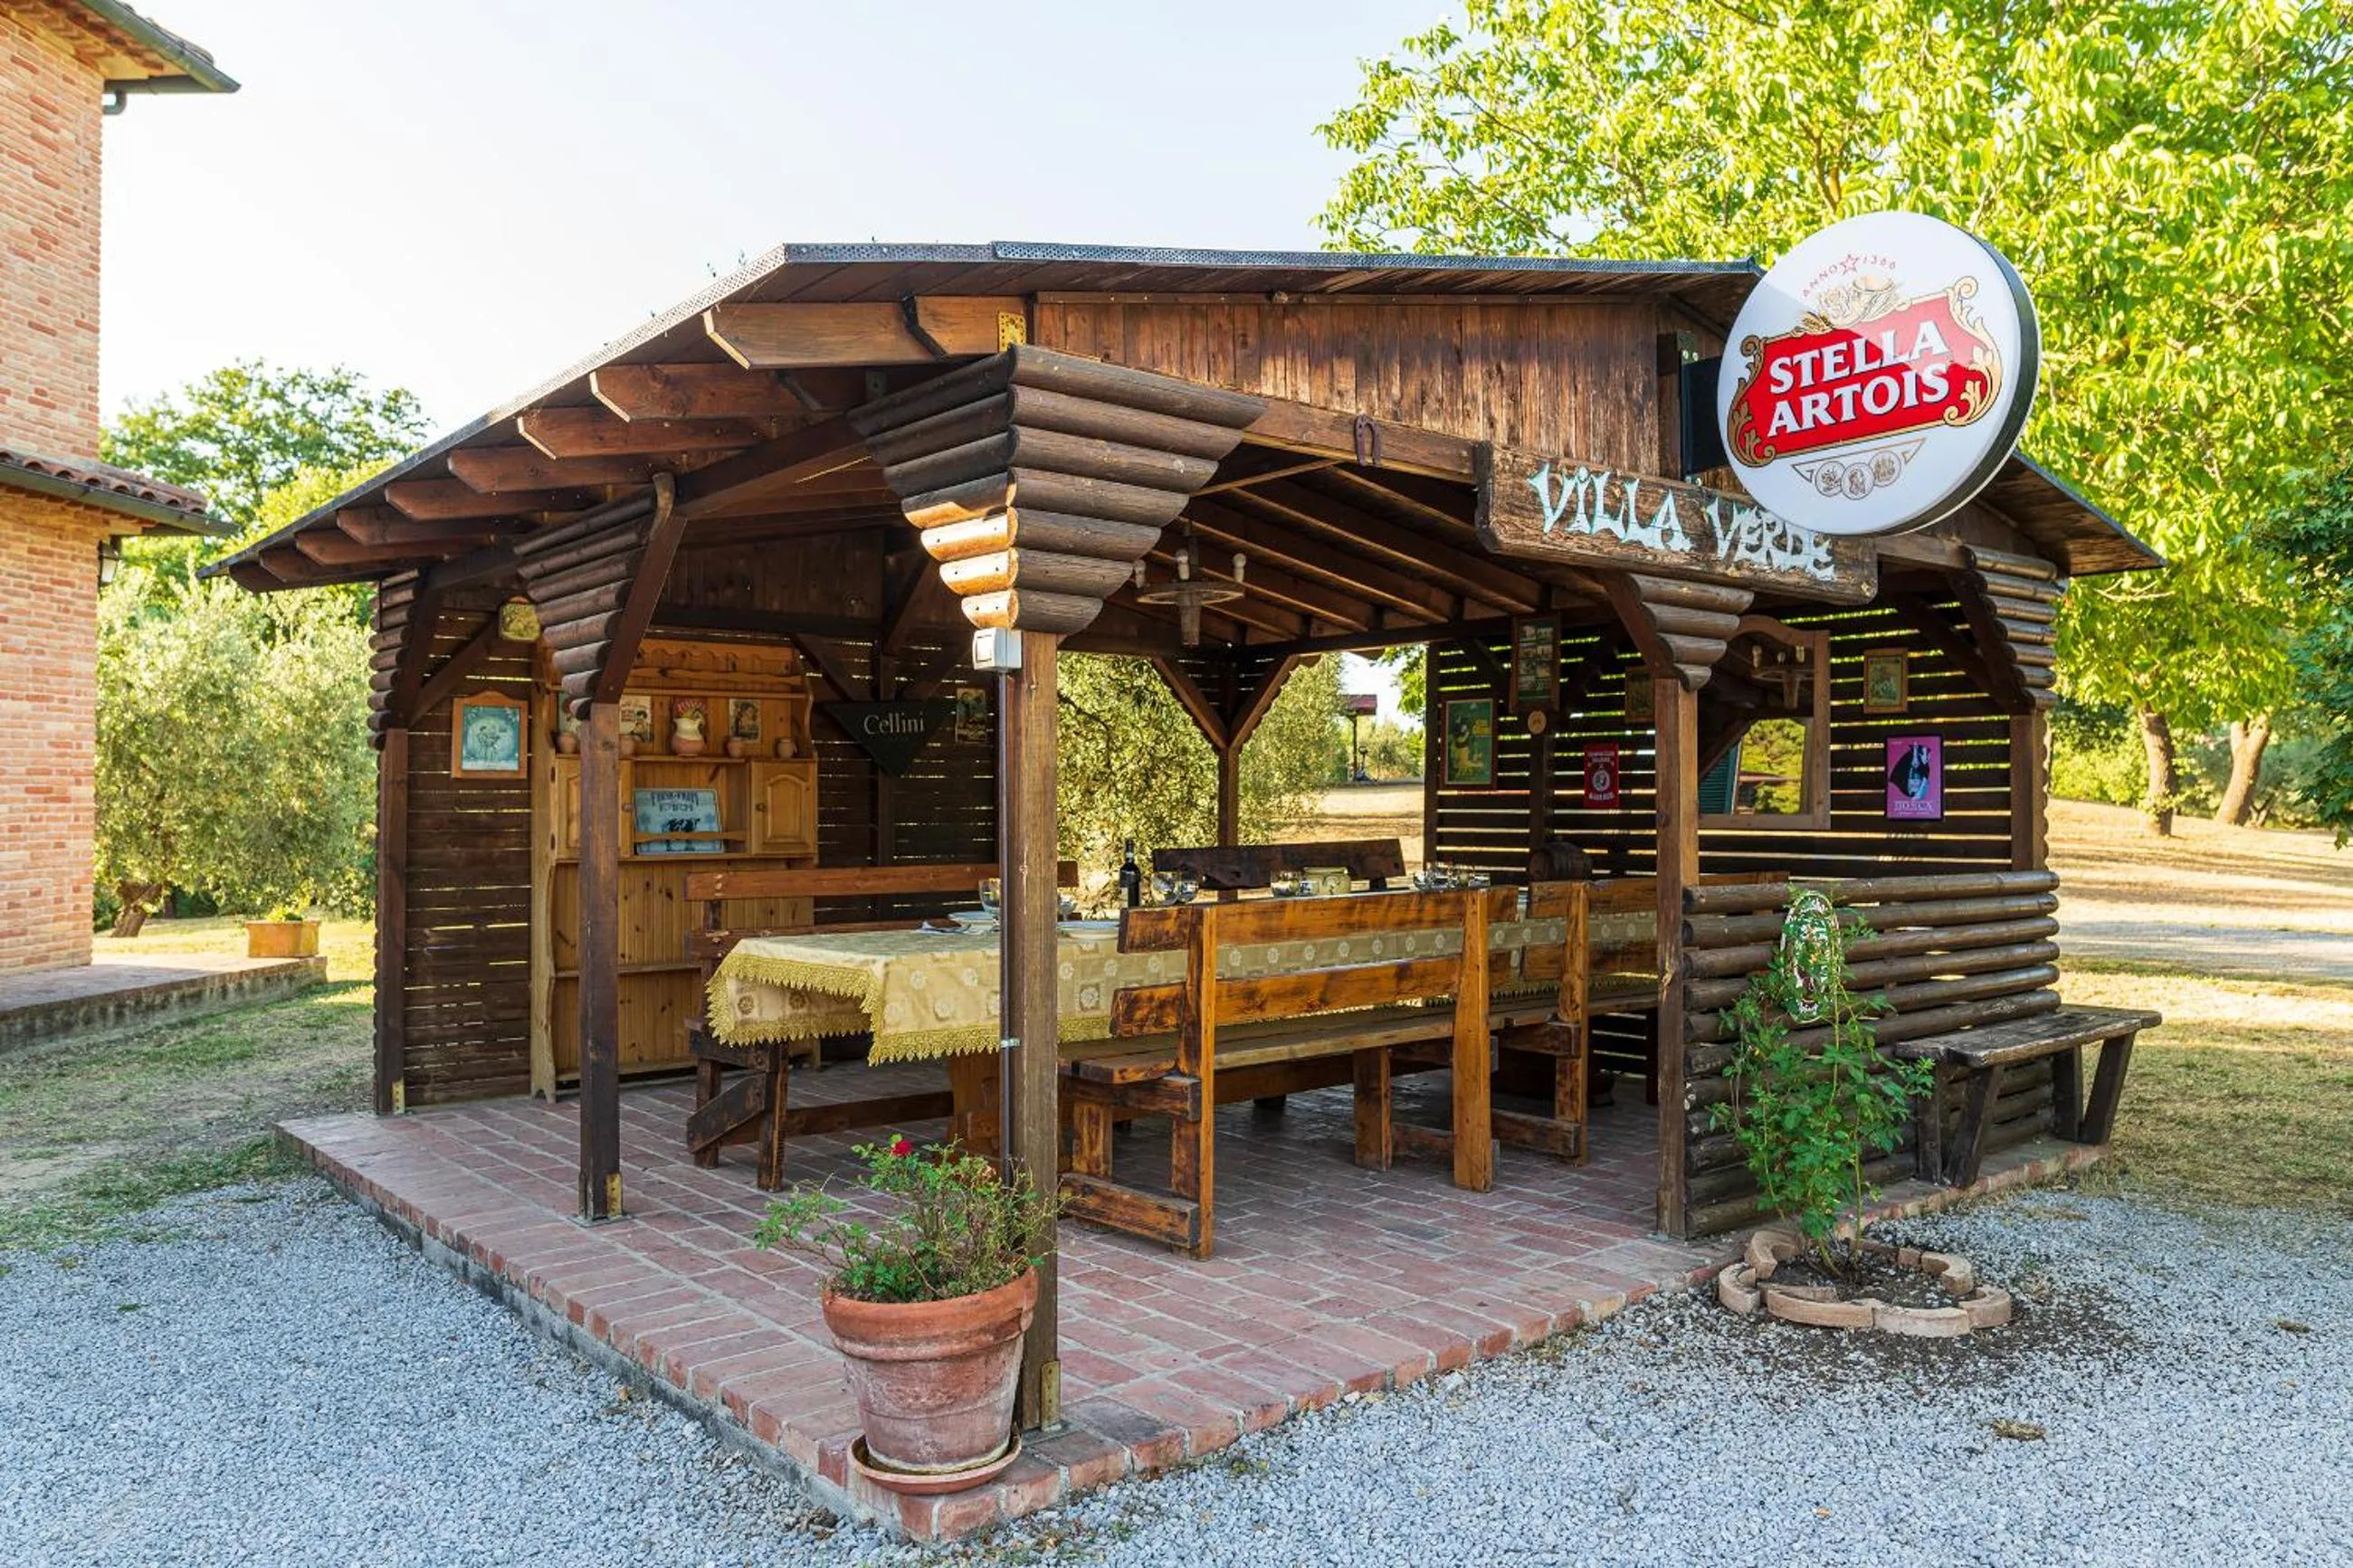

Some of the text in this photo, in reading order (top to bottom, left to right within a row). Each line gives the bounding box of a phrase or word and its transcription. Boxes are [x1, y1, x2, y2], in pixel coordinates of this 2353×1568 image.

[1768, 320, 1951, 395] STELLA
[1767, 363, 1952, 439] ARTOIS
[1705, 497, 1837, 582] VERDE
[863, 711, 925, 736] Cellini
